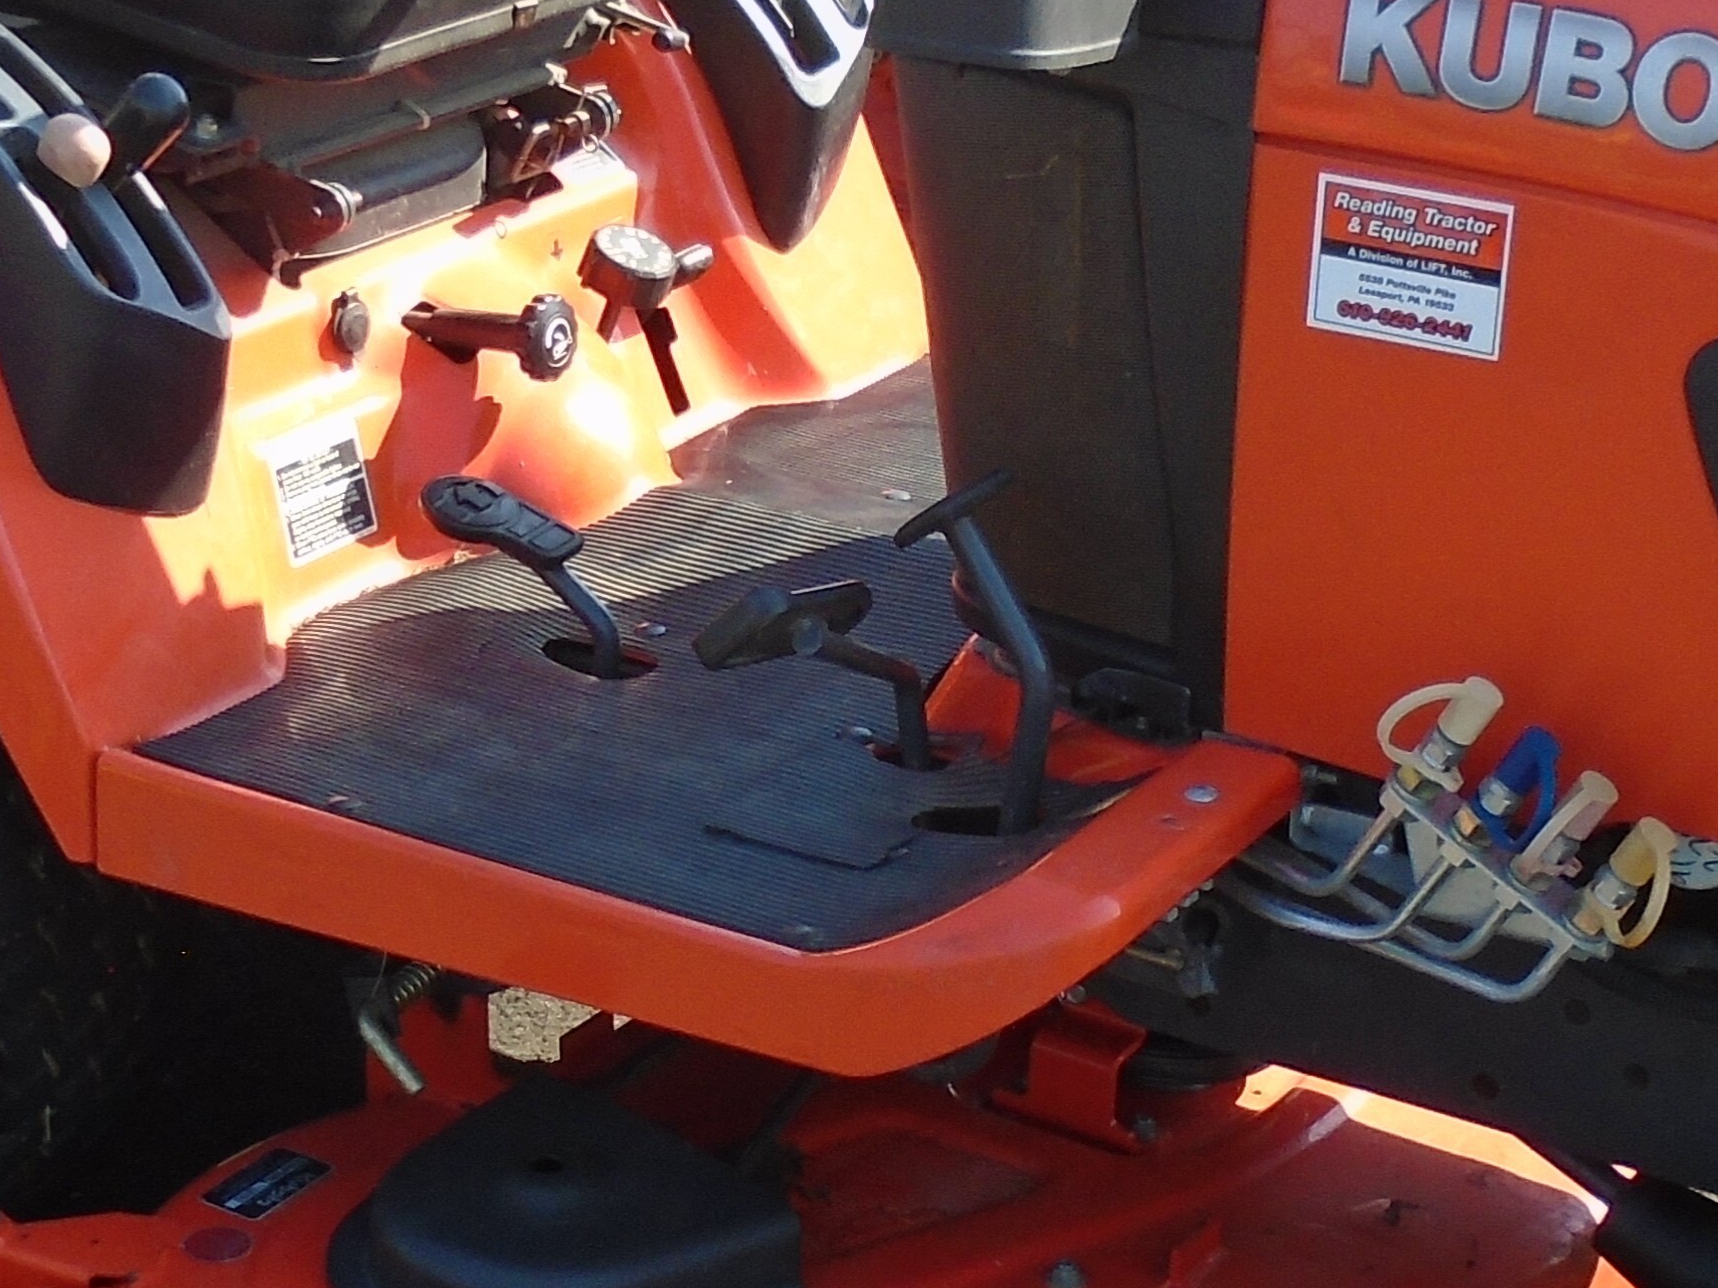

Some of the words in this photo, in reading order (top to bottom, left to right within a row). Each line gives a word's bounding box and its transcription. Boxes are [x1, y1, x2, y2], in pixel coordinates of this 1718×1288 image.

[1334, 191, 1417, 225] Reading
[1423, 207, 1498, 237] Tractor
[1347, 216, 1362, 234] &
[1366, 219, 1480, 255] Equipment
[1347, 246, 1356, 258] A
[1359, 247, 1404, 267] Division
[1406, 257, 1418, 269] of
[1407, 294, 1421, 306] PA
